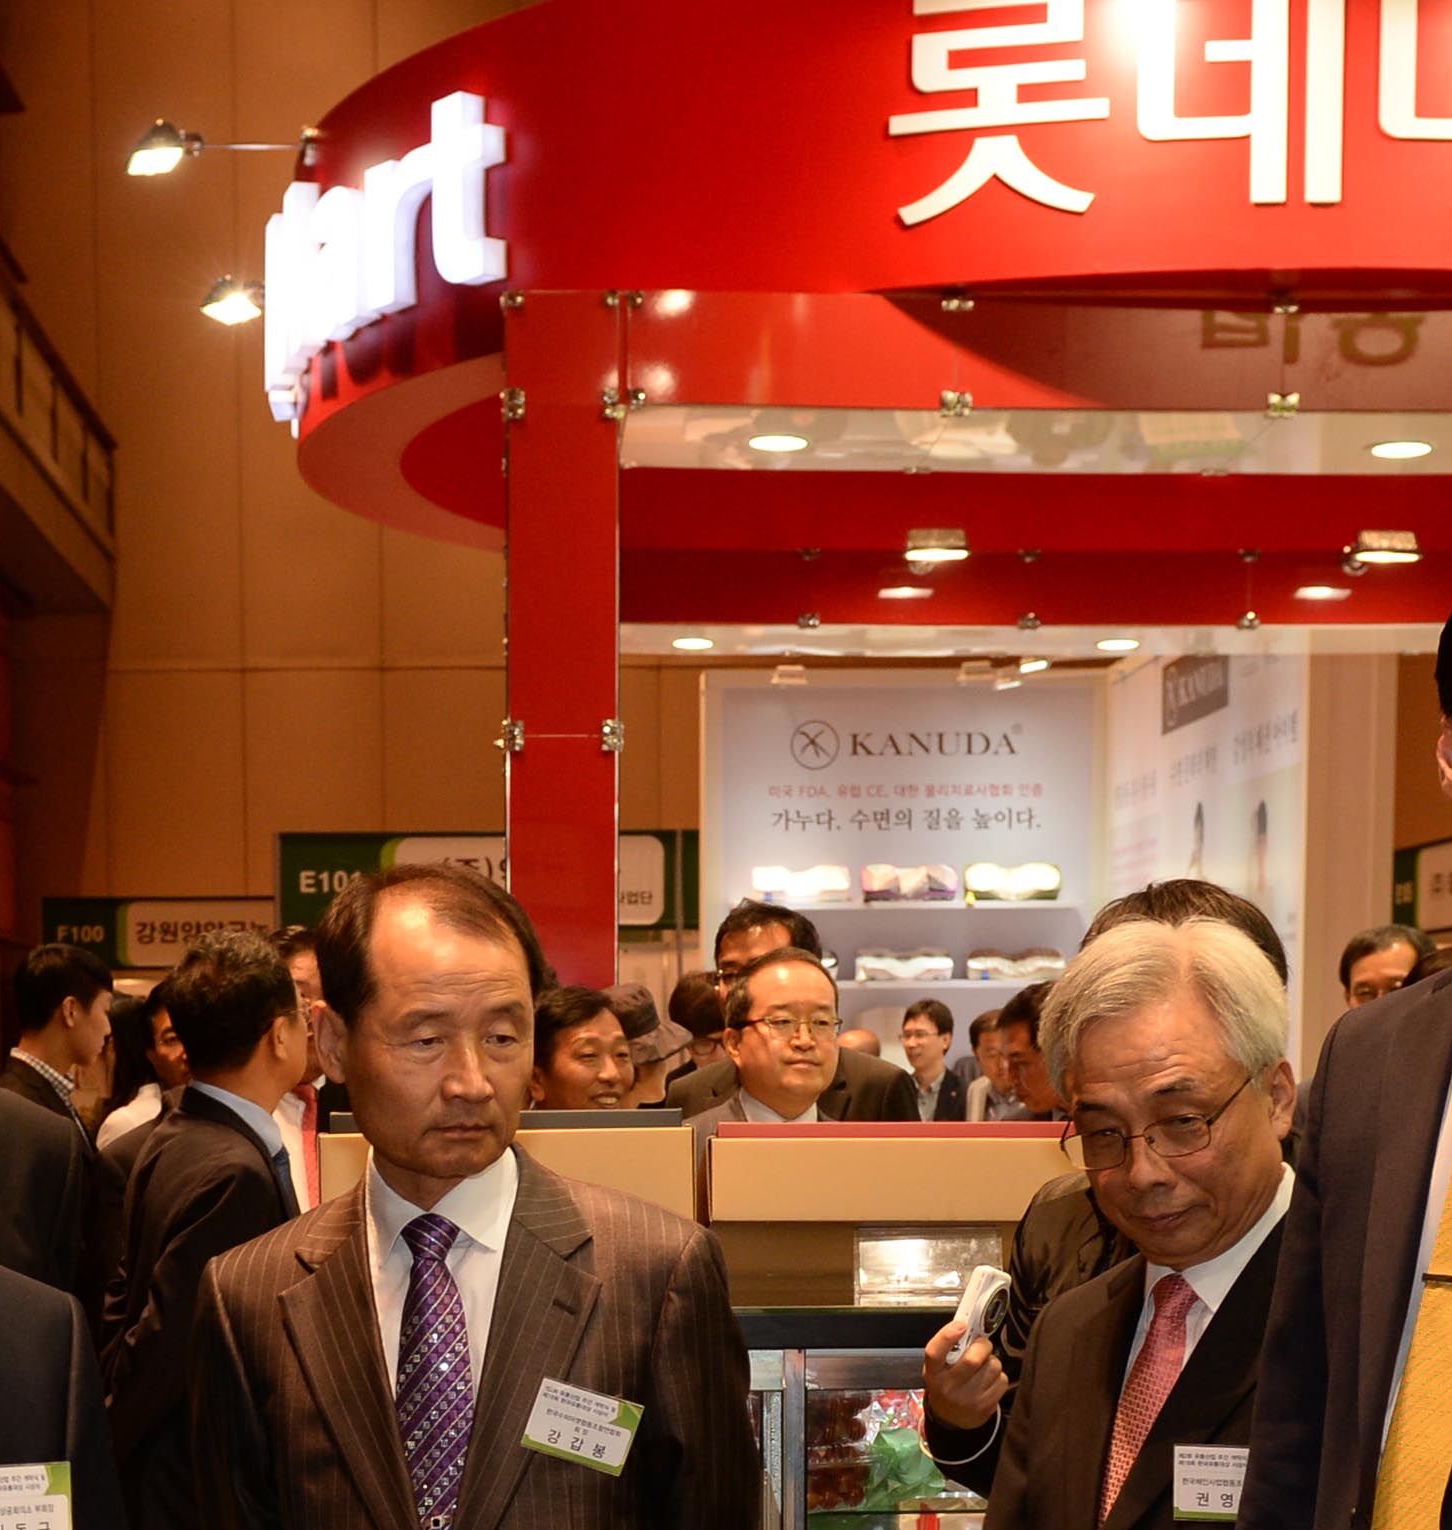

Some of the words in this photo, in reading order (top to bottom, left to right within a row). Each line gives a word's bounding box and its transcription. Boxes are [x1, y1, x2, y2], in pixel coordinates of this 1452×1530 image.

[848, 731, 1021, 757] KANUDA
[772, 808, 842, 832] 가누다.
[850, 807, 914, 832] 수면의
[922, 807, 964, 831] 질을
[971, 807, 1043, 831] 높이다.
[57, 924, 105, 943] F100
